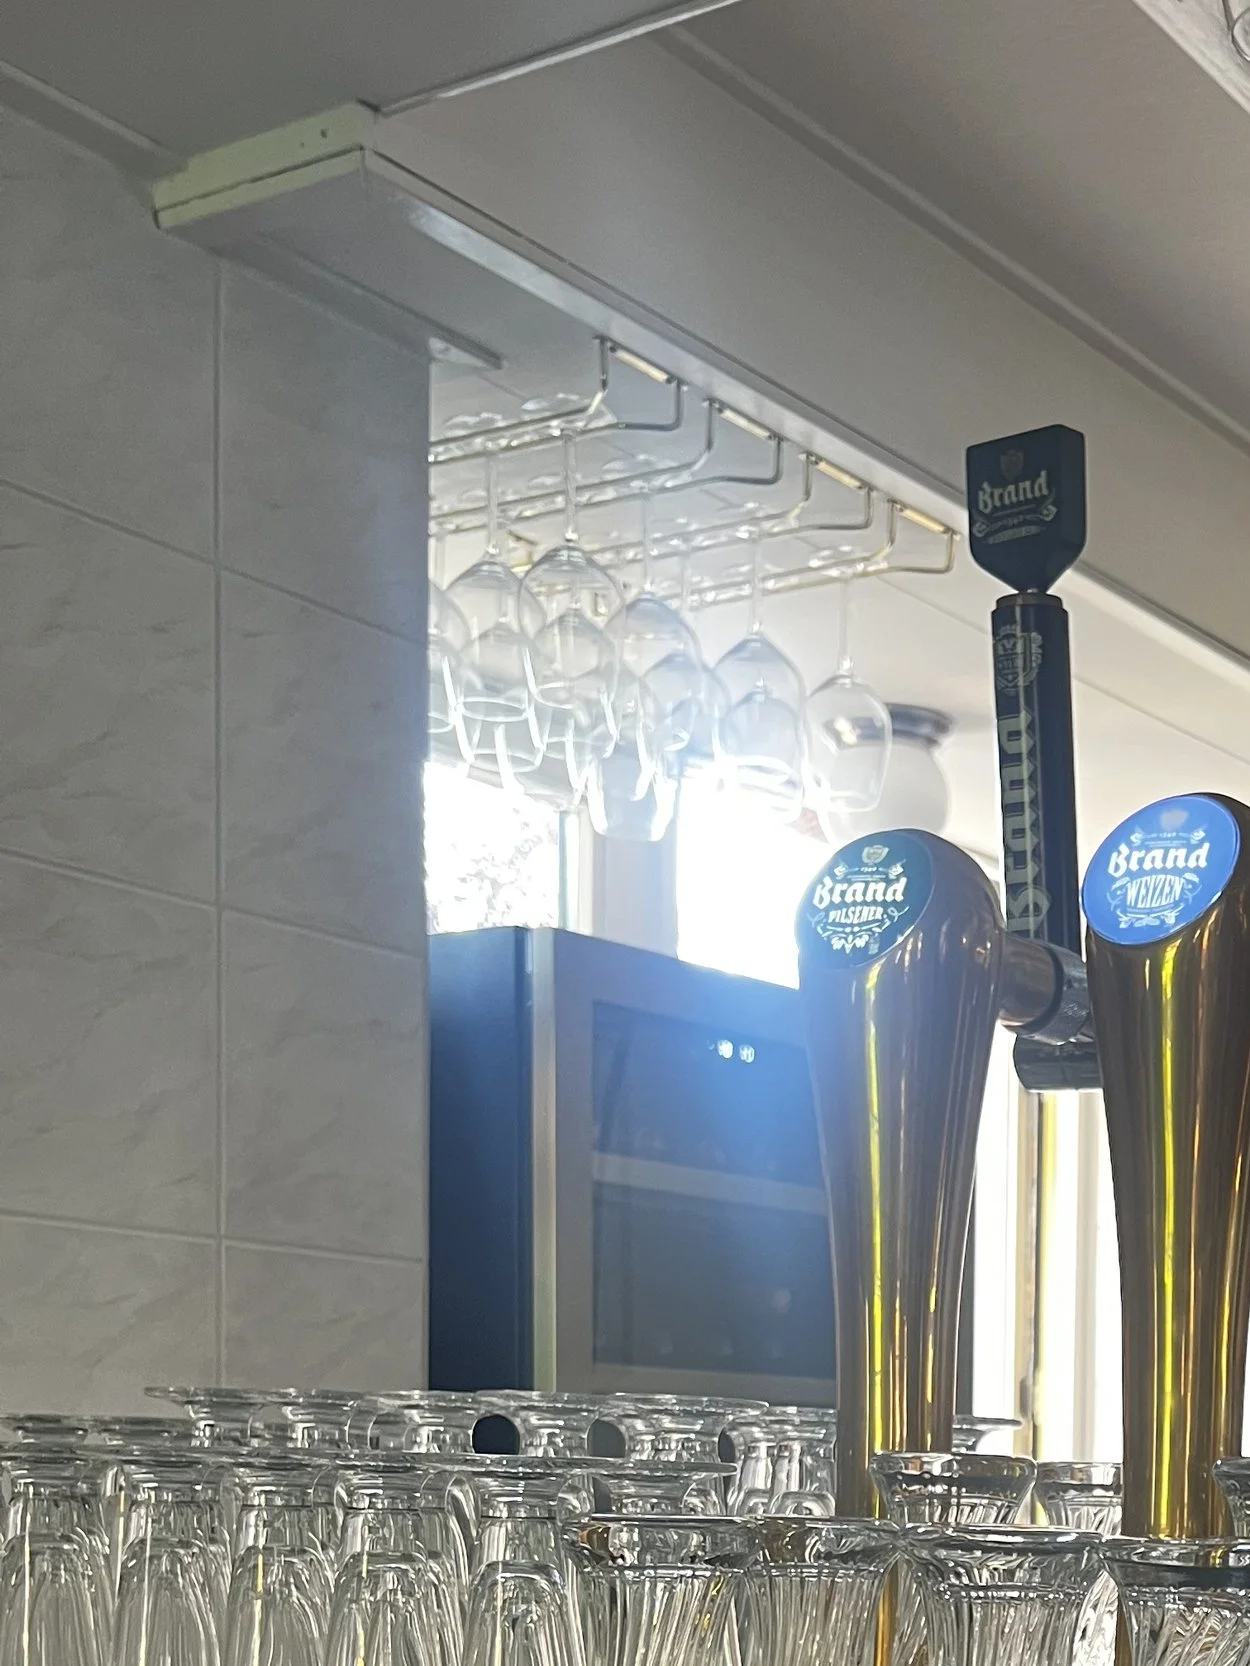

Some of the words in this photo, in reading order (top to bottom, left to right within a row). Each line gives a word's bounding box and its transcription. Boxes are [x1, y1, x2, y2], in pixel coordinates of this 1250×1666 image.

[978, 470, 1049, 514] Brand
[1107, 842, 1210, 878] Brand
[812, 876, 908, 909] Brand
[1127, 874, 1185, 909] WEIZEN
[828, 905, 884, 924] PILSENER
